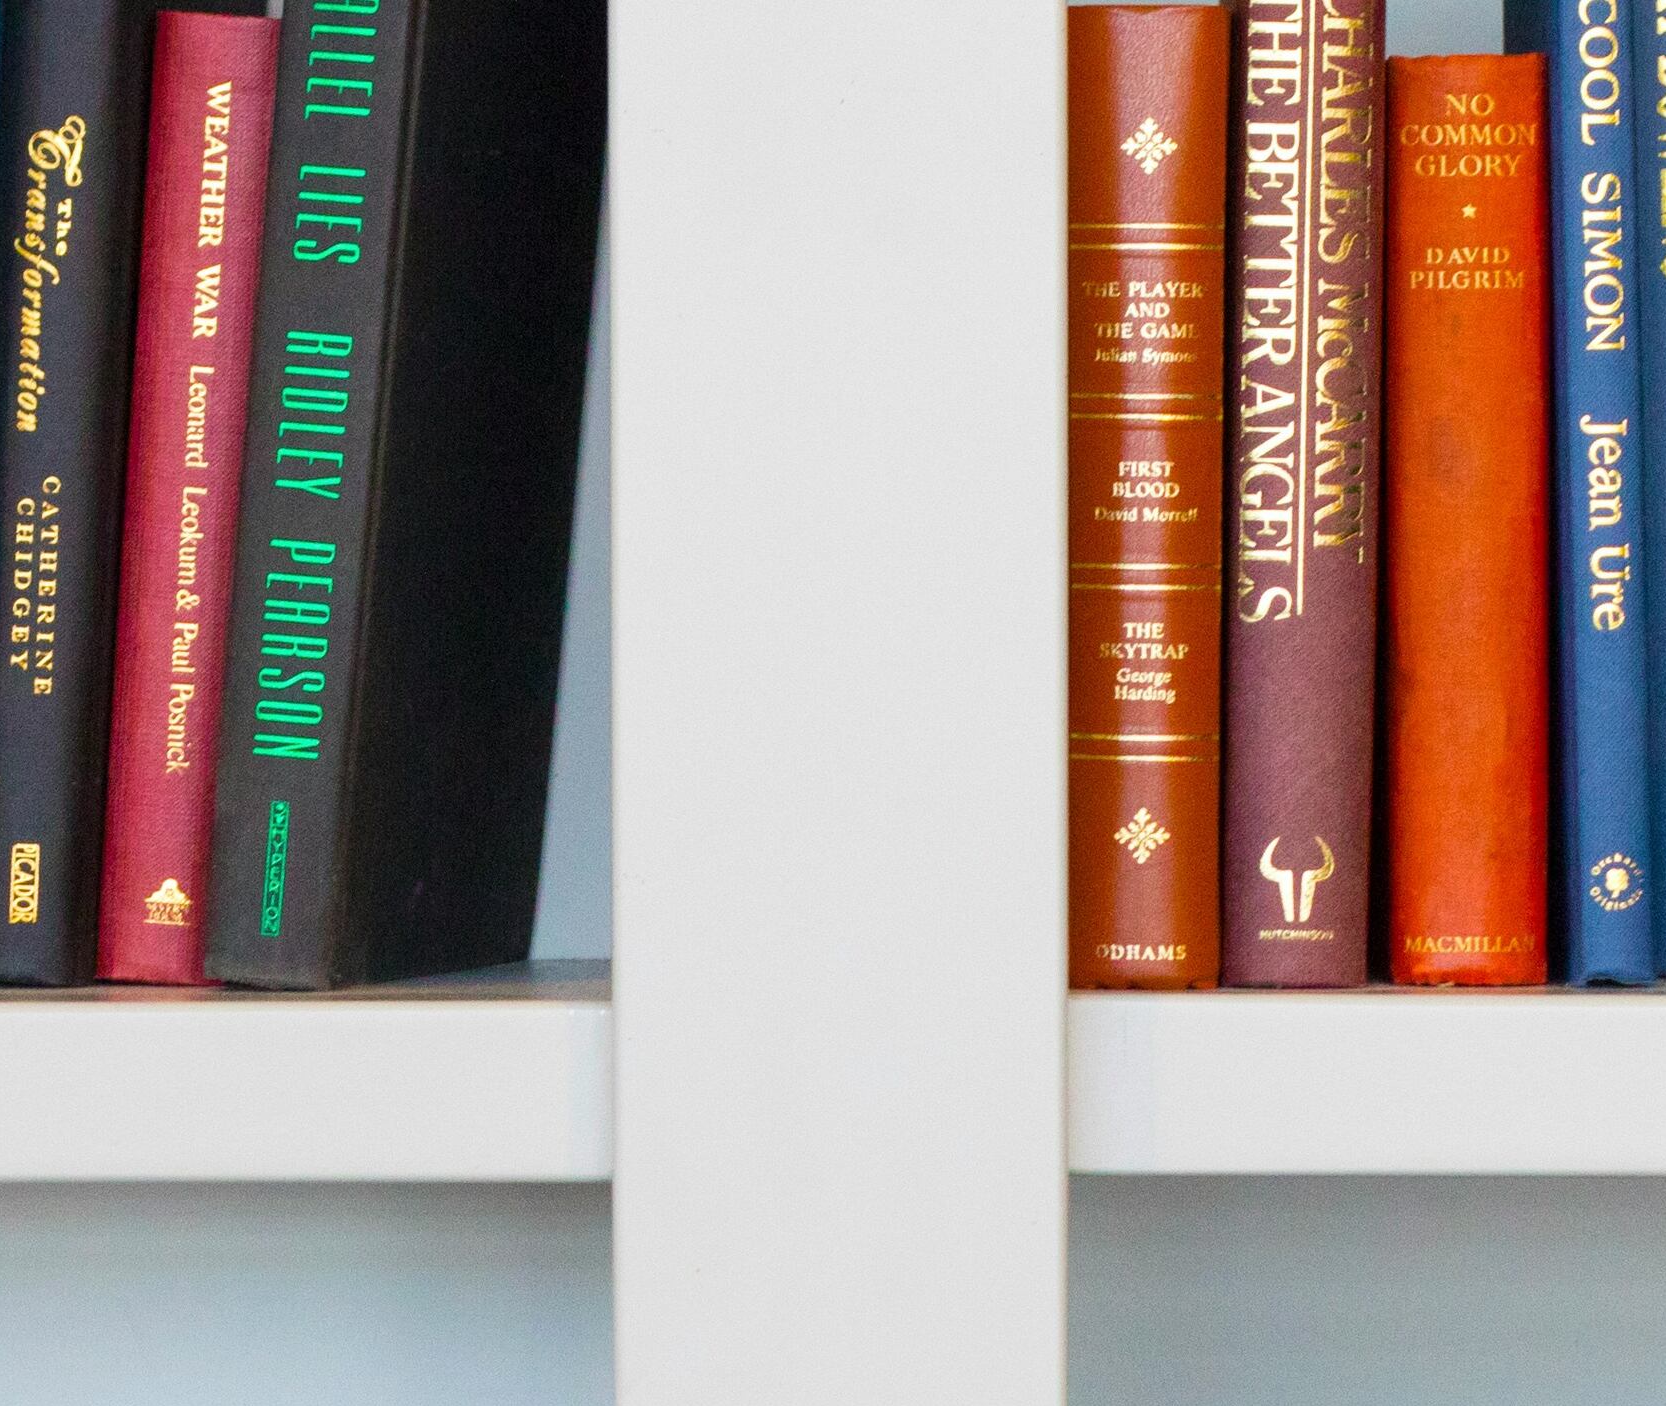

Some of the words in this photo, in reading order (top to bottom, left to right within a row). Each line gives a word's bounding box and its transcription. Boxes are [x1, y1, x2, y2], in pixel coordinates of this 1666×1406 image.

[1400, 123, 1537, 146] COMMON
[1445, 94, 1495, 116] NO
[198, 82, 232, 247] WEATHER
[1414, 154, 1521, 178] GLORY
[55, 198, 72, 256] The
[1243, 121, 1300, 365] BETTER
[1427, 247, 1509, 265] DAVID
[1580, 172, 1625, 350] SIMON
[14, 115, 86, 432] Transformation
[192, 264, 221, 338] WAR
[1412, 270, 1522, 290] PILGRIM
[185, 365, 215, 468] Leonard
[275, 331, 353, 499] RIDLEY
[1113, 480, 1179, 499] BLOOD
[1118, 461, 1173, 478] FIRST
[1241, 376, 1295, 622] ANGELS
[1579, 414, 1627, 531] Jean
[10, 498, 35, 670] CHIDGEY
[33, 476, 61, 694] CATHERINE
[1590, 544, 1630, 630] Ure
[172, 622, 199, 673] Paul
[253, 539, 336, 759] PEARSON
[166, 683, 195, 773] Posnick
[9, 843, 40, 924] PICADOR
